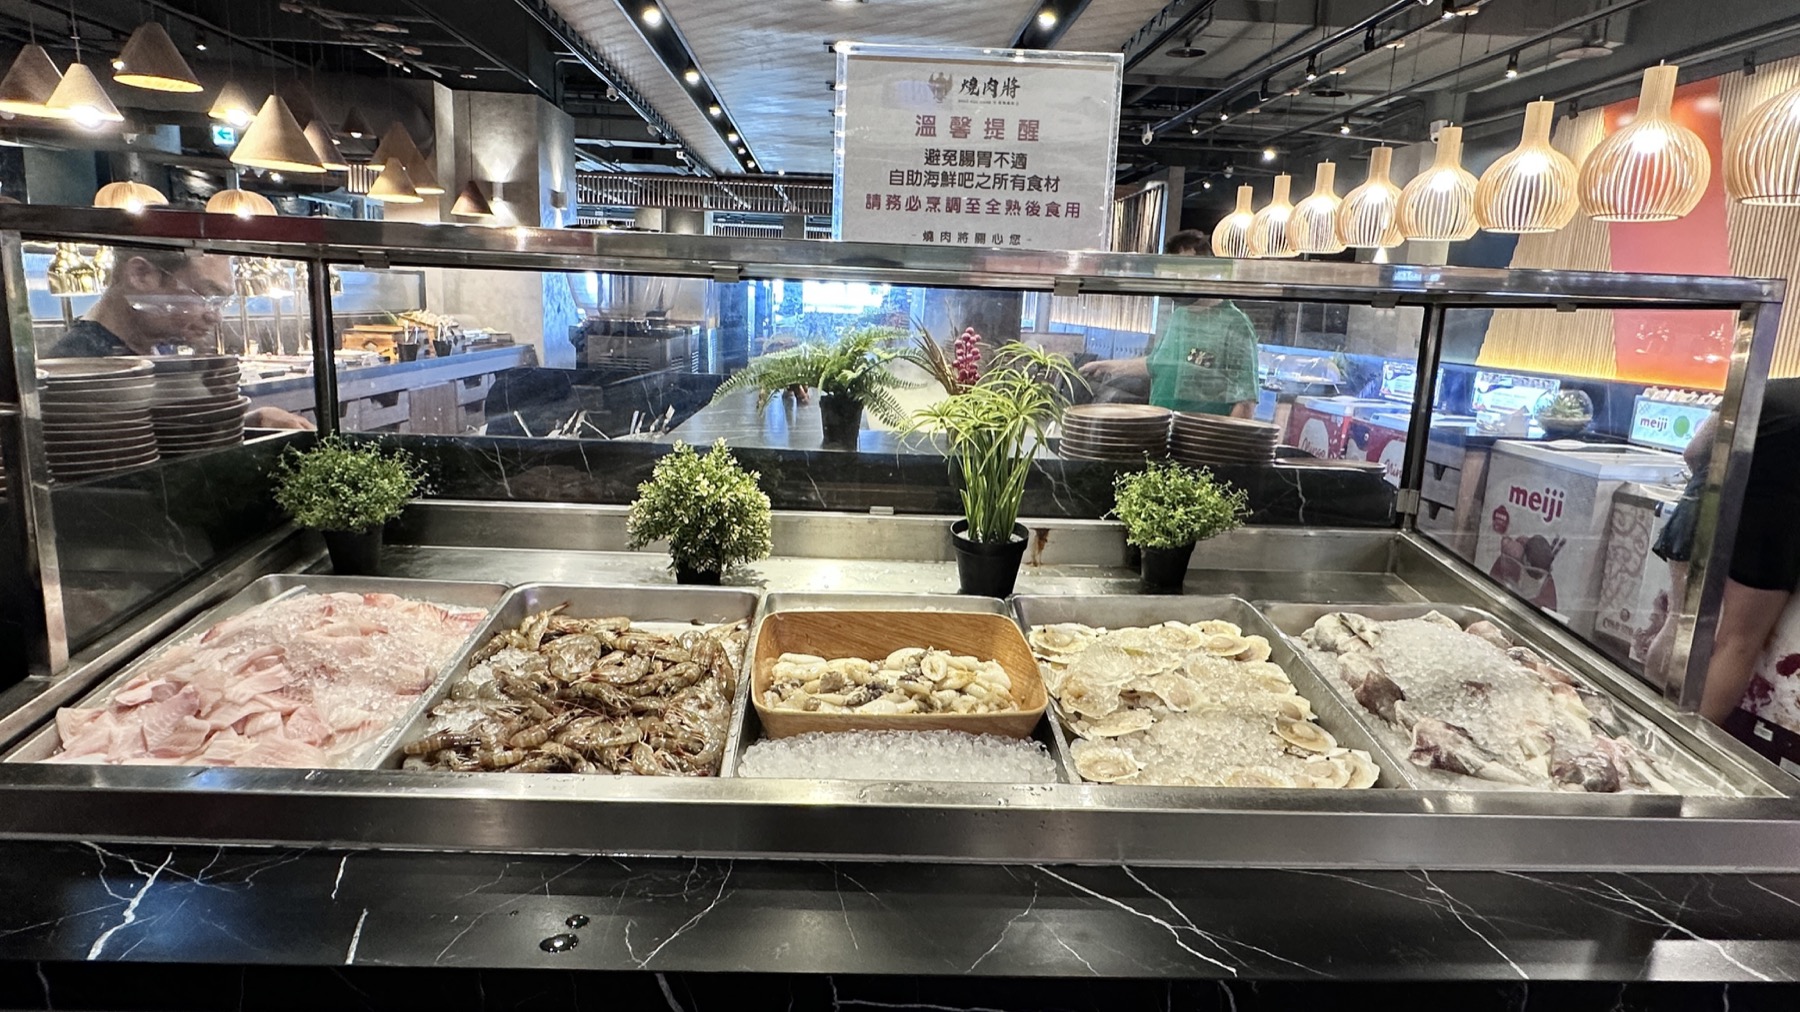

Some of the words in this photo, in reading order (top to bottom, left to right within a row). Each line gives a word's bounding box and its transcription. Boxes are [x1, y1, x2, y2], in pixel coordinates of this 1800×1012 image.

[958, 76, 1021, 99] 燒肉將
[915, 114, 1040, 142] 溫馨提醒
[924, 148, 1028, 170] 避免腸胃不適
[889, 169, 1061, 193] 自助海鮮吧之所有食材
[865, 193, 1081, 219] 請務必烹調至全熟後食用
[1640, 417, 1668, 432] meiji
[1509, 485, 1565, 523] meiji
